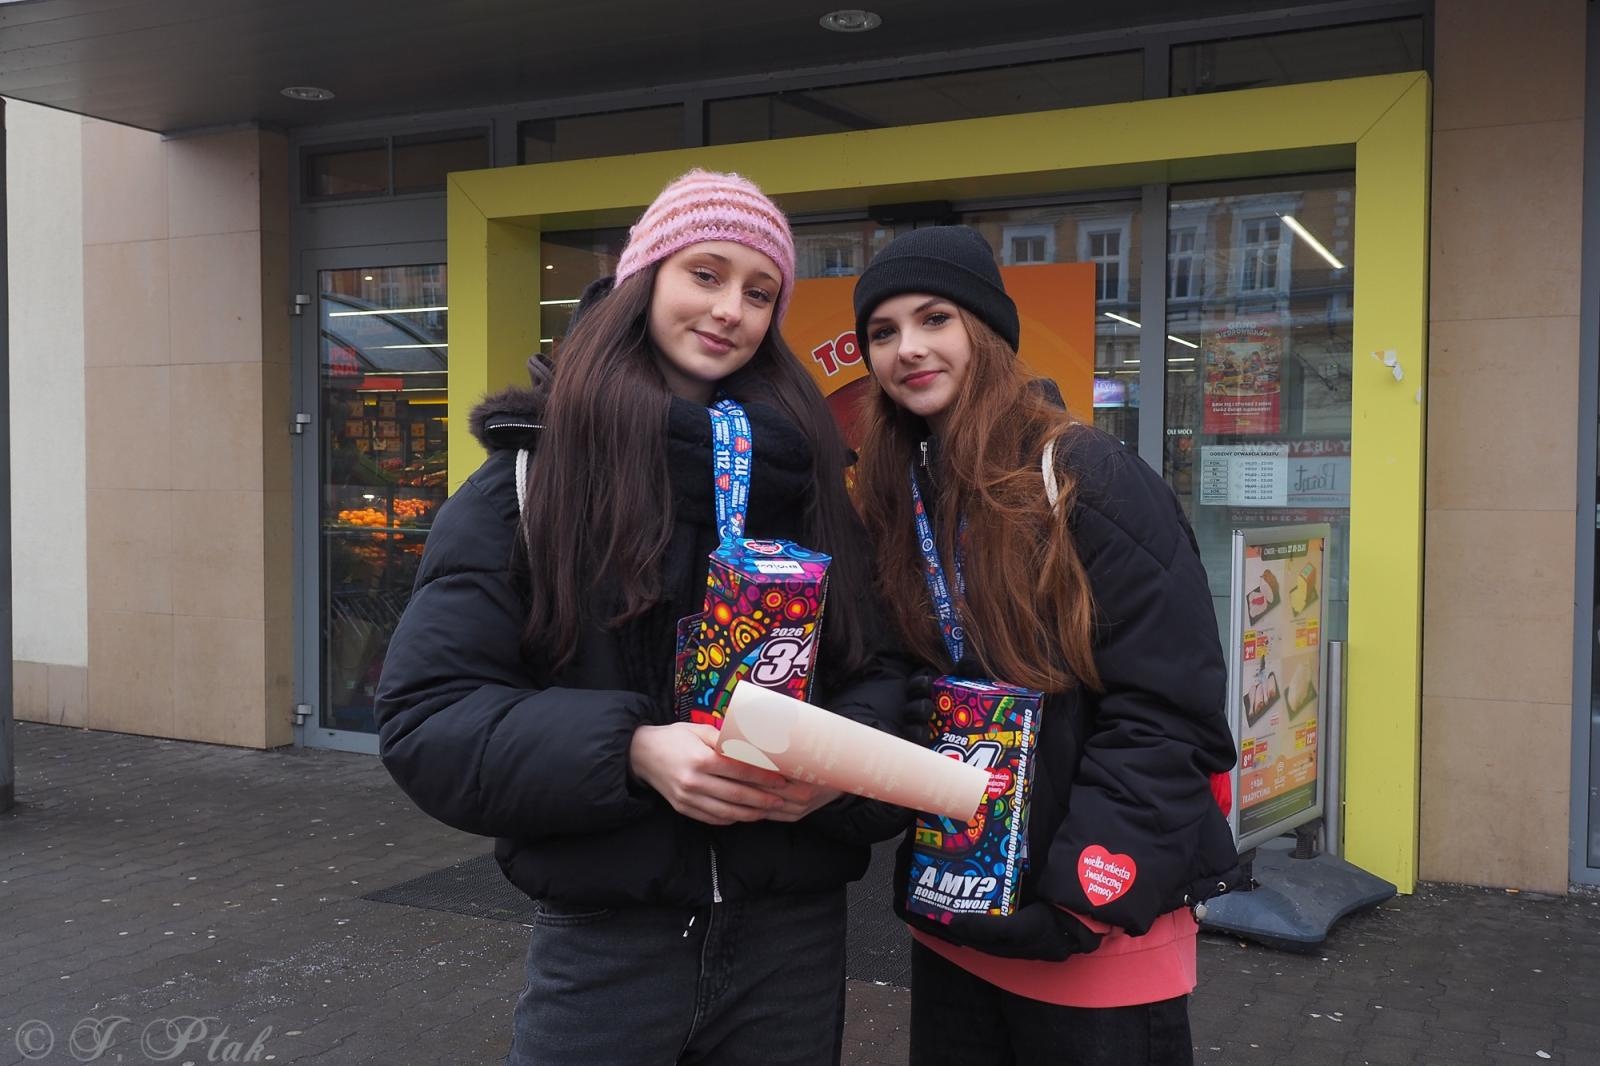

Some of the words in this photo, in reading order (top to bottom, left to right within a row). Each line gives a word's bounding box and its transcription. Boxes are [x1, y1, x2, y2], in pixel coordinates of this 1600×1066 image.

[716, 449, 730, 469] 112
[734, 456, 749, 476] 112
[938, 602, 951, 620] 112
[770, 627, 804, 638] 2026
[941, 732, 969, 747] 2026
[1020, 708, 1033, 755] CHOROBY
[1014, 753, 1027, 807] PRZEWODU
[1005, 806, 1021, 878] POKARMOWEGO
[1083, 856, 1105, 869] wielka
[1104, 862, 1131, 880] orkiestra
[918, 866, 937, 888] A
[938, 871, 997, 898] MY?
[1004, 878, 1012, 887] U
[1087, 883, 1114, 901] pomocy
[914, 886, 953, 909] ROBIMY
[952, 899, 992, 910] SWOJE
[1001, 886, 1011, 917] DZIECI
